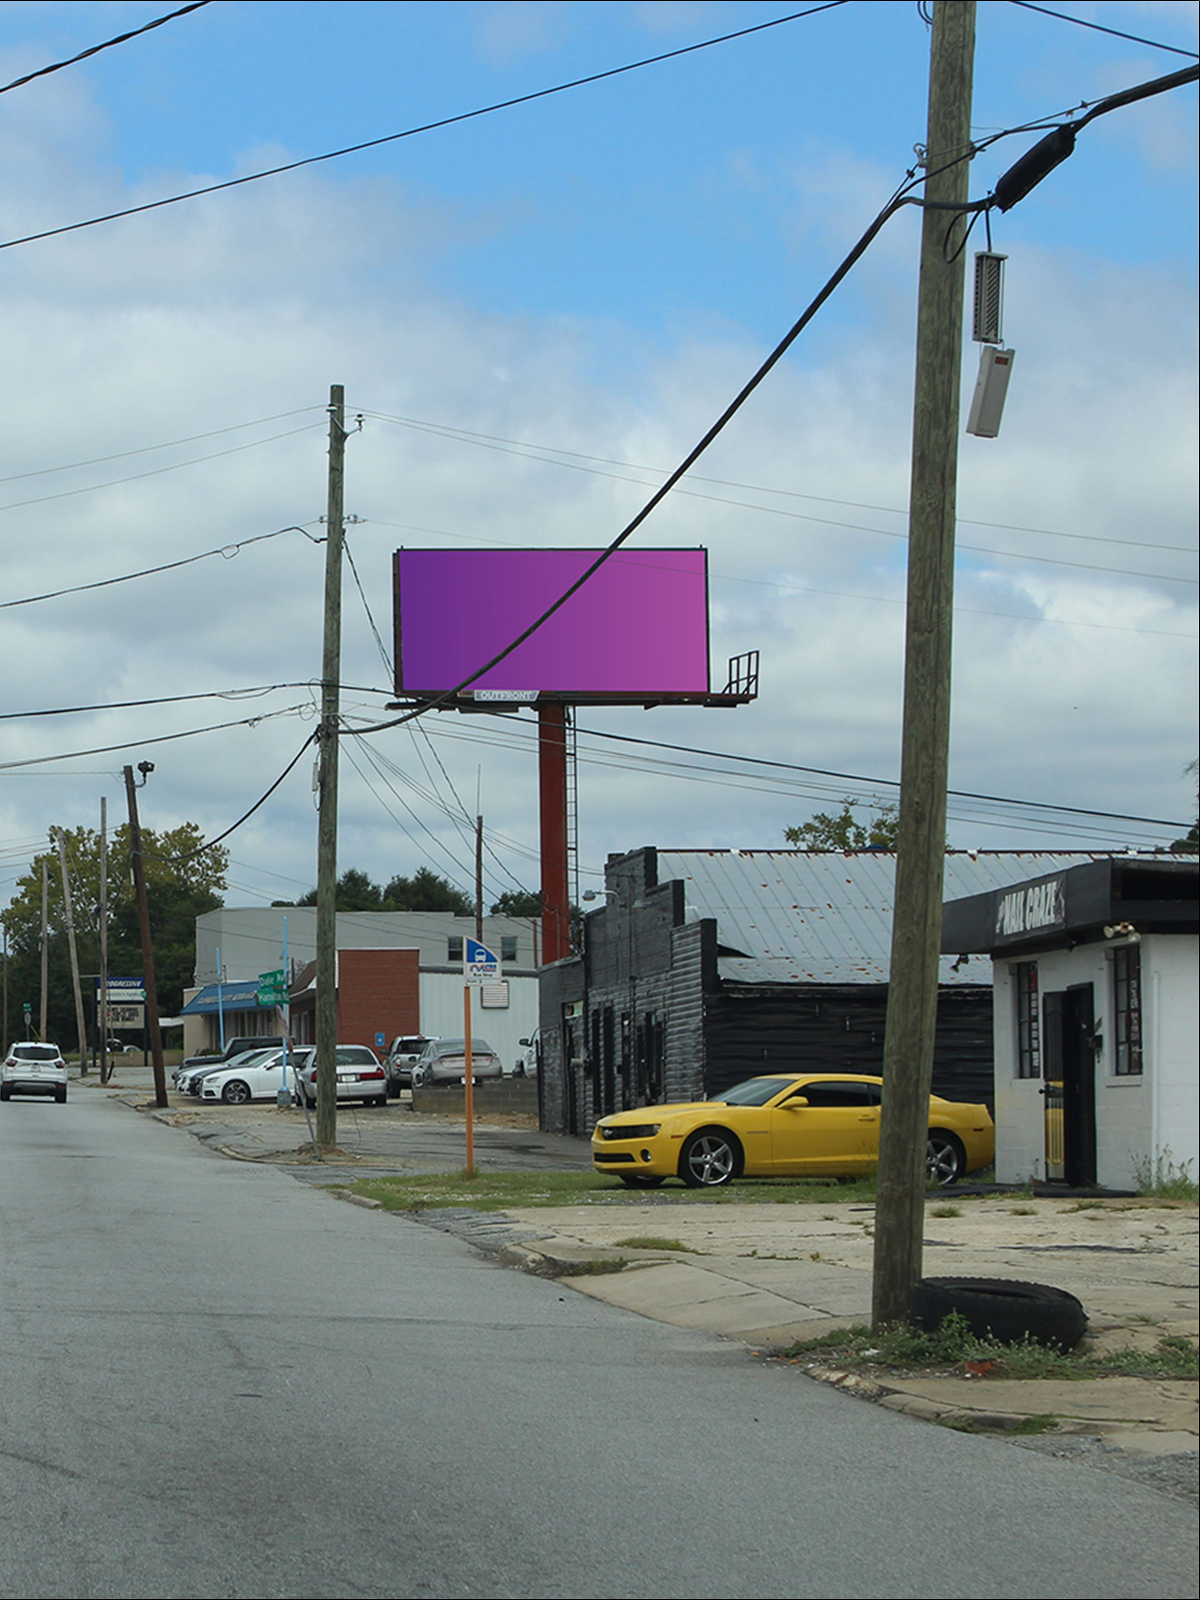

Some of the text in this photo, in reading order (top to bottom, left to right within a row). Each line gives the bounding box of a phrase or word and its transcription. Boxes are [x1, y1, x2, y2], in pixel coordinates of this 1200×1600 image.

[480, 690, 534, 700] OUTFRONT
[1003, 881, 1058, 936] NAIL CRAZE
[260, 976, 275, 988] Dale
[259, 991, 282, 1003] Hamilton
